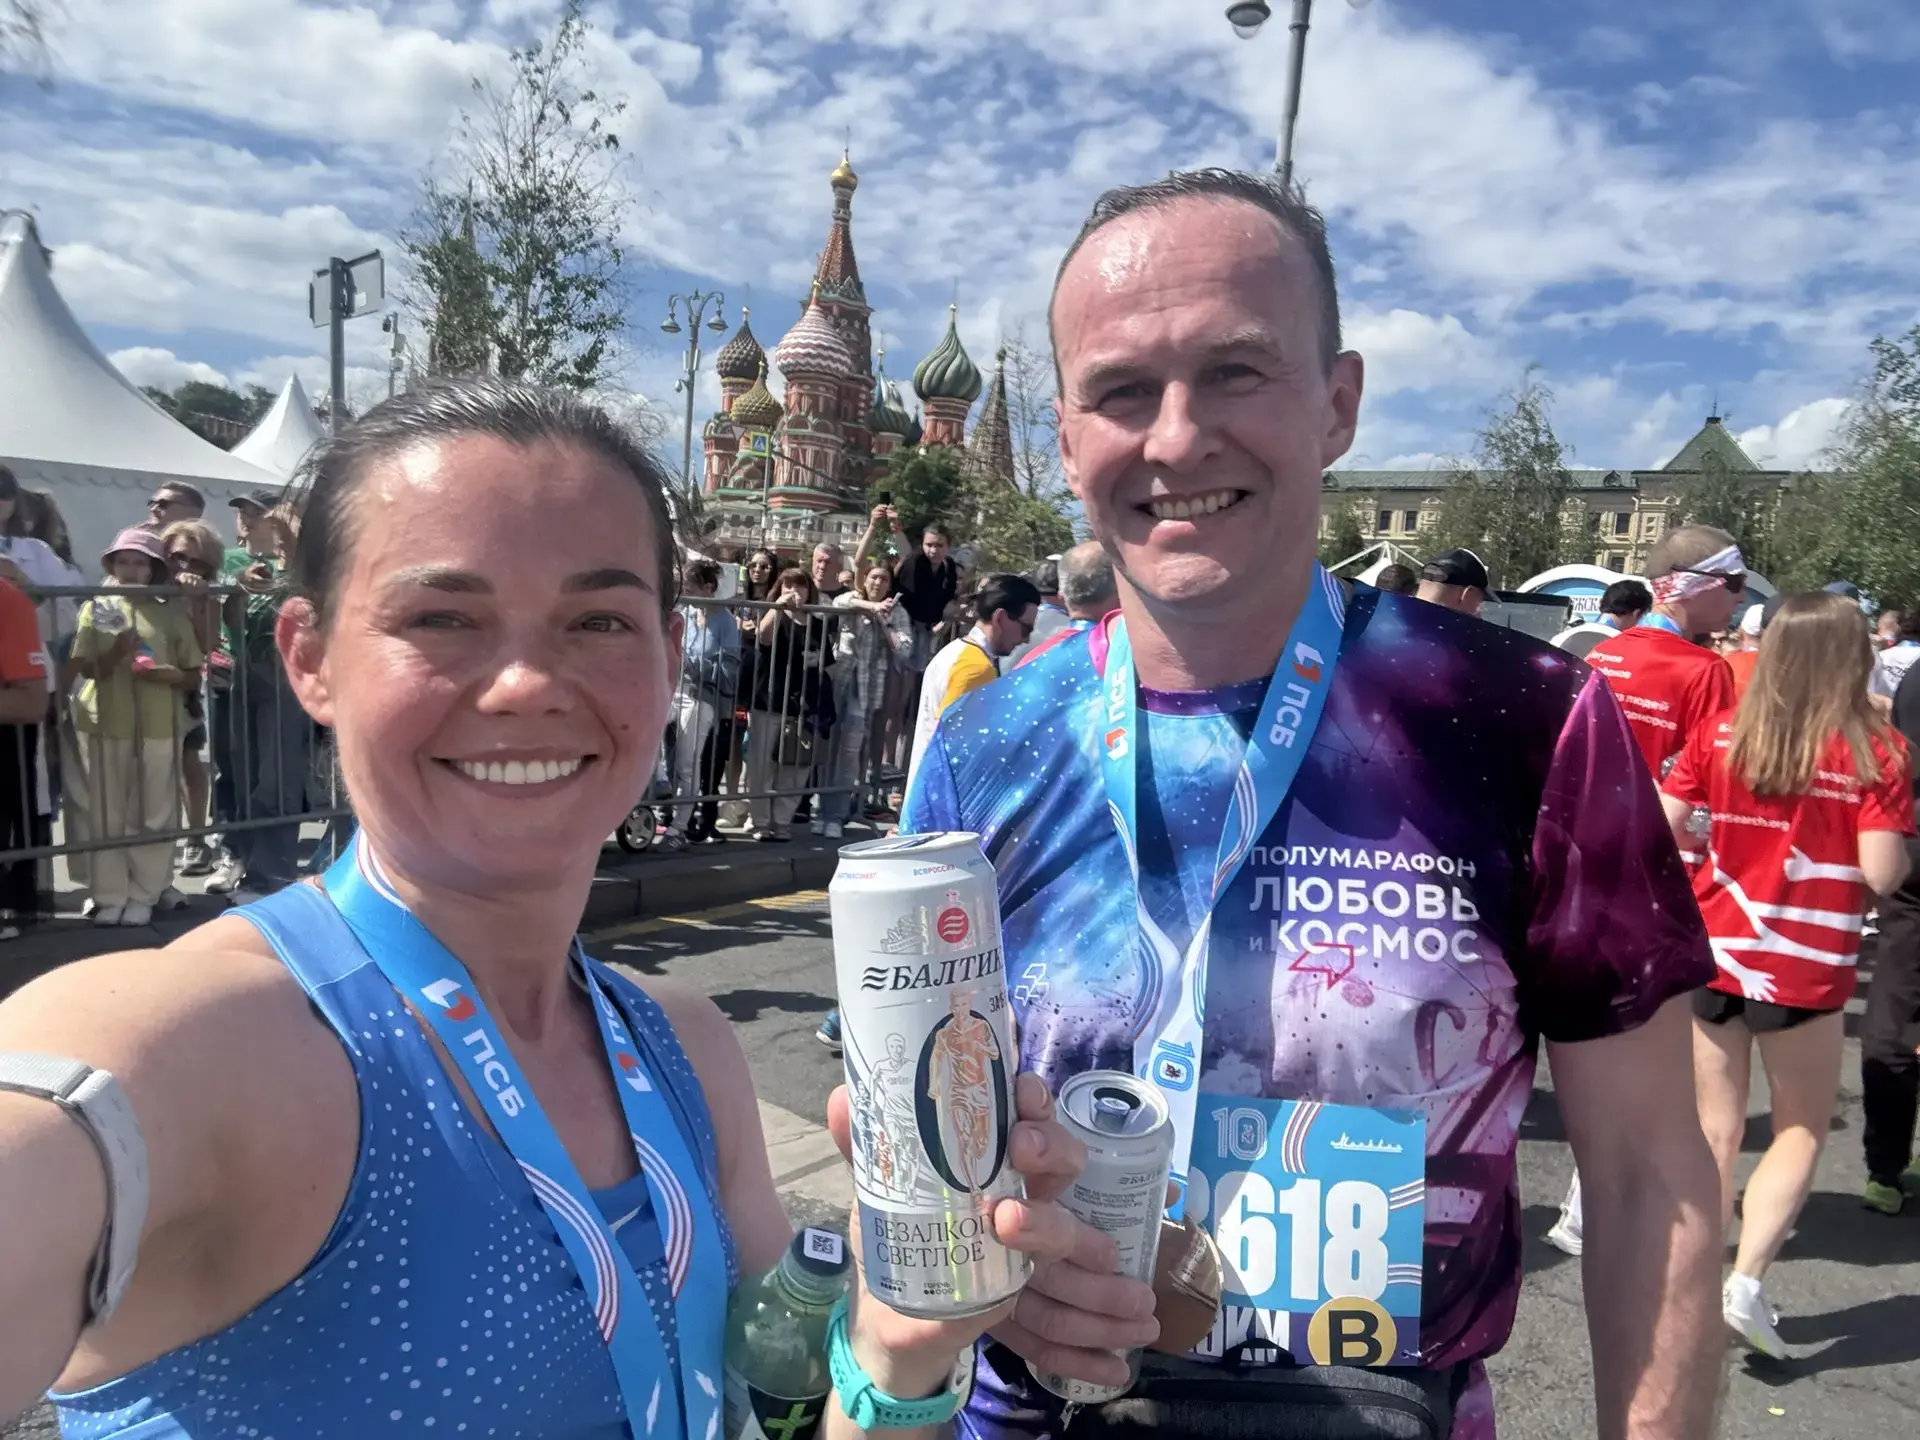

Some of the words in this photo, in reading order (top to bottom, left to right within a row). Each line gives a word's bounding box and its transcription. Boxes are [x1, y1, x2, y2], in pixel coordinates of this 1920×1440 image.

[1269, 682, 1312, 748] ПСБ
[1251, 846, 1476, 878] ПОЛУМАРАФОН
[1250, 877, 1480, 921] ЛЮБОВЬ
[1271, 920, 1483, 963] КОСМОС
[462, 1028, 526, 1118] ПСБ
[1153, 1039, 1195, 1092] 10
[1211, 1107, 1267, 1160] 10
[877, 1241, 985, 1268] СВЕТЛОЕ
